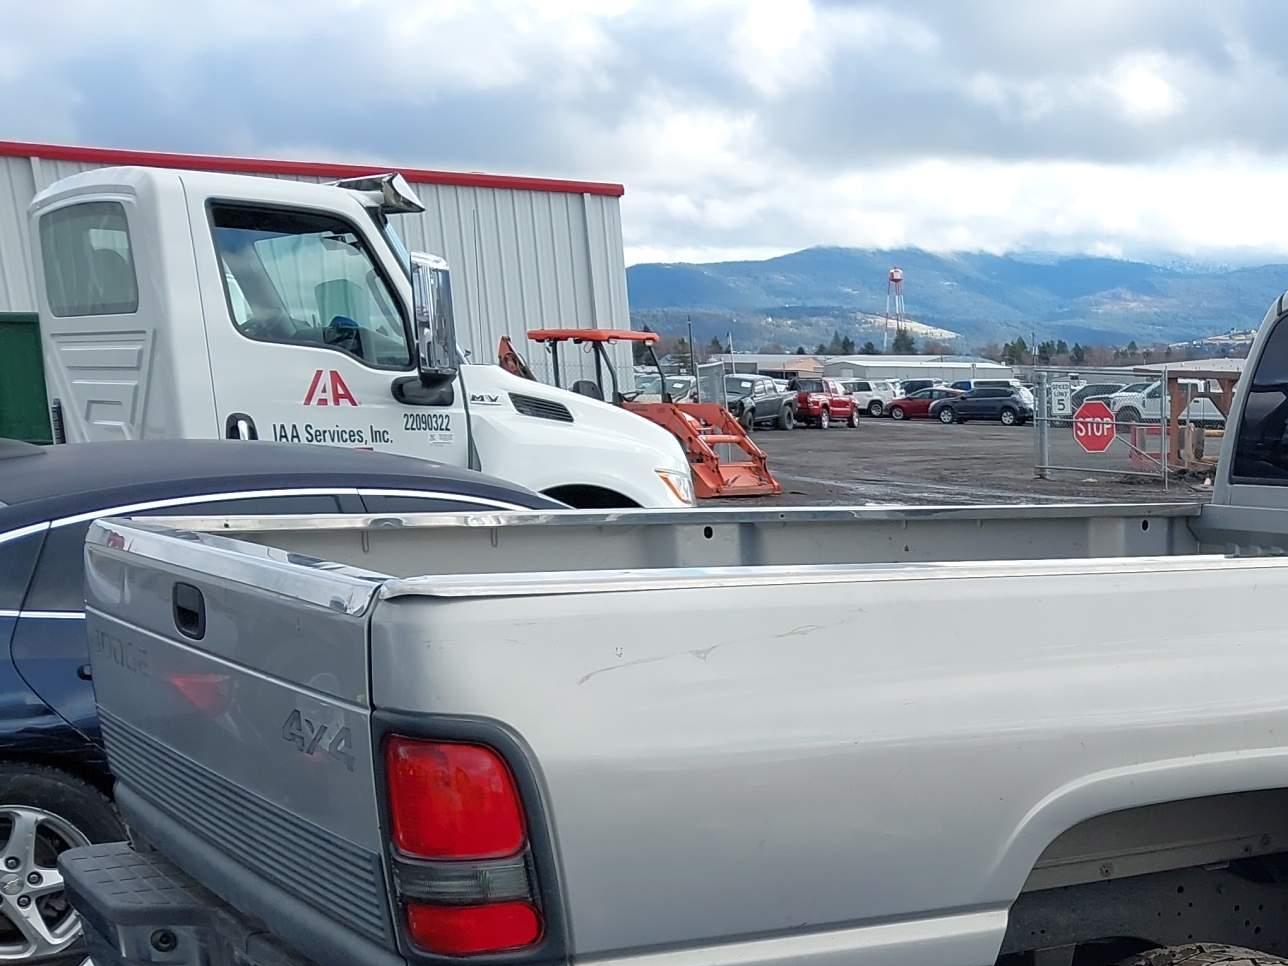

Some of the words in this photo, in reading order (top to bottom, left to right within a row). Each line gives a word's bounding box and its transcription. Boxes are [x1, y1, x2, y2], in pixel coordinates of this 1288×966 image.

[1057, 399, 1066, 411] 5
[403, 413, 451, 432] 22090322
[1077, 417, 1112, 437] STOP
[272, 423, 301, 442] IAA
[305, 423, 368, 446] Services,
[369, 425, 394, 444] Inc.
